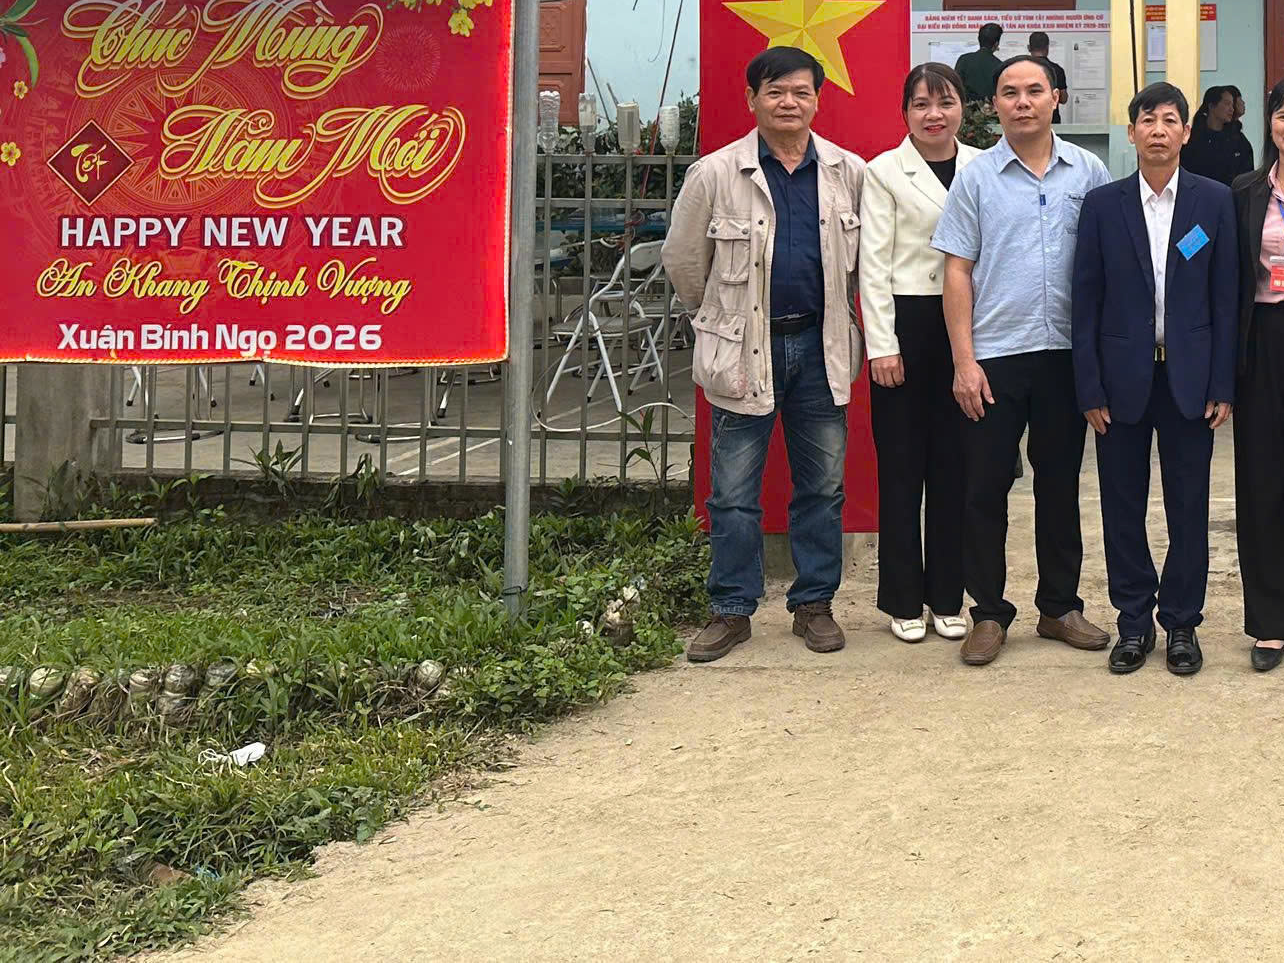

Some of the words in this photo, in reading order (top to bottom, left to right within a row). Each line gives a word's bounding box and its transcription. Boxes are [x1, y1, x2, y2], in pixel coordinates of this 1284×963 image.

[70, 142, 111, 185] Tết
[158, 104, 316, 181] Năm
[253, 104, 467, 209] Mới
[61, 217, 188, 247] HAPPY
[204, 217, 289, 247] NEW
[304, 216, 405, 248] YEAR
[35, 256, 97, 300] An
[103, 257, 210, 315] Khang
[217, 258, 309, 305] Thịnh
[316, 256, 412, 315] Vượng
[56, 321, 137, 351] Xuân
[142, 321, 210, 351] Bính
[214, 323, 279, 358] Ngọ
[285, 324, 382, 351] 2026
